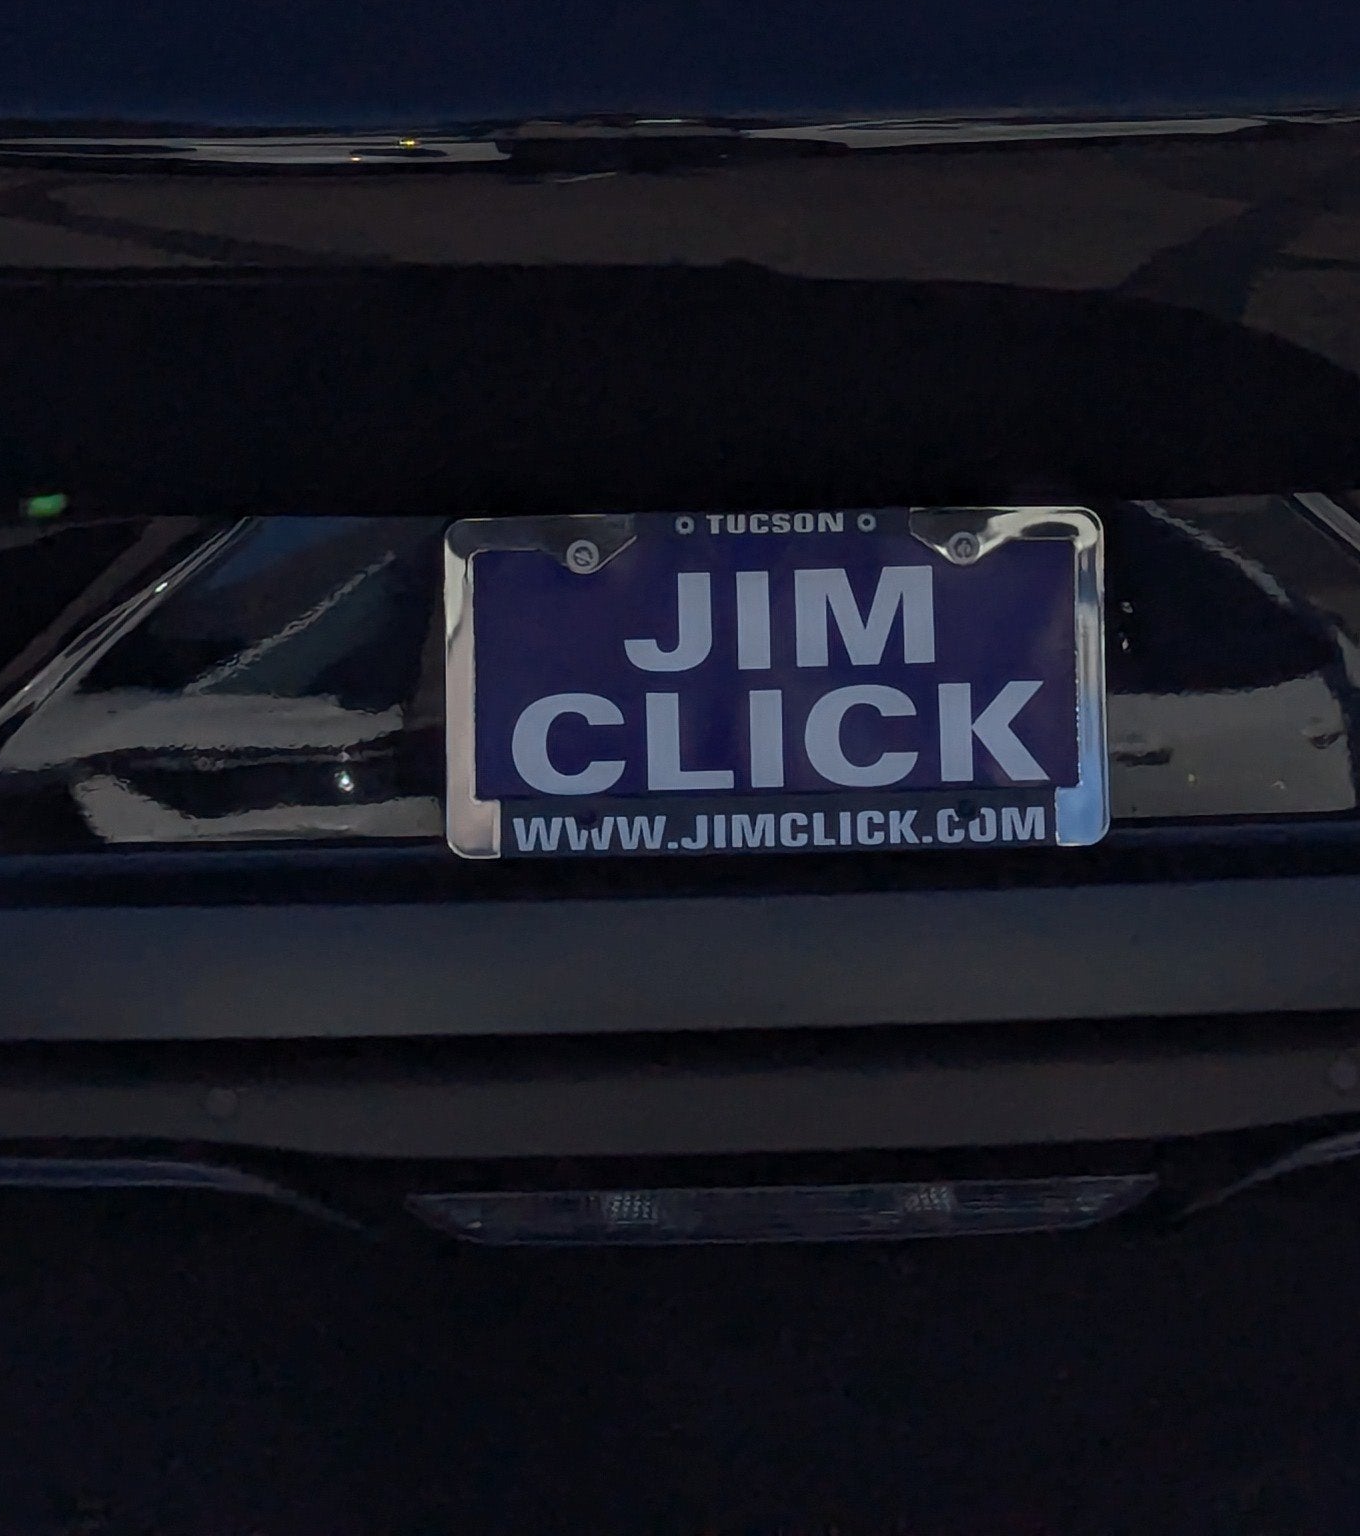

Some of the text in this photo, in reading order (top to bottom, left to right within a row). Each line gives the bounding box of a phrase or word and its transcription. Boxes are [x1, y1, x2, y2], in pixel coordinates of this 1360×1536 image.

[706, 512, 844, 534] TUCSON
[624, 565, 935, 672] JIM
[511, 680, 1050, 796] CLICK
[512, 806, 1046, 852] WWW.JIMCLICK.COM
